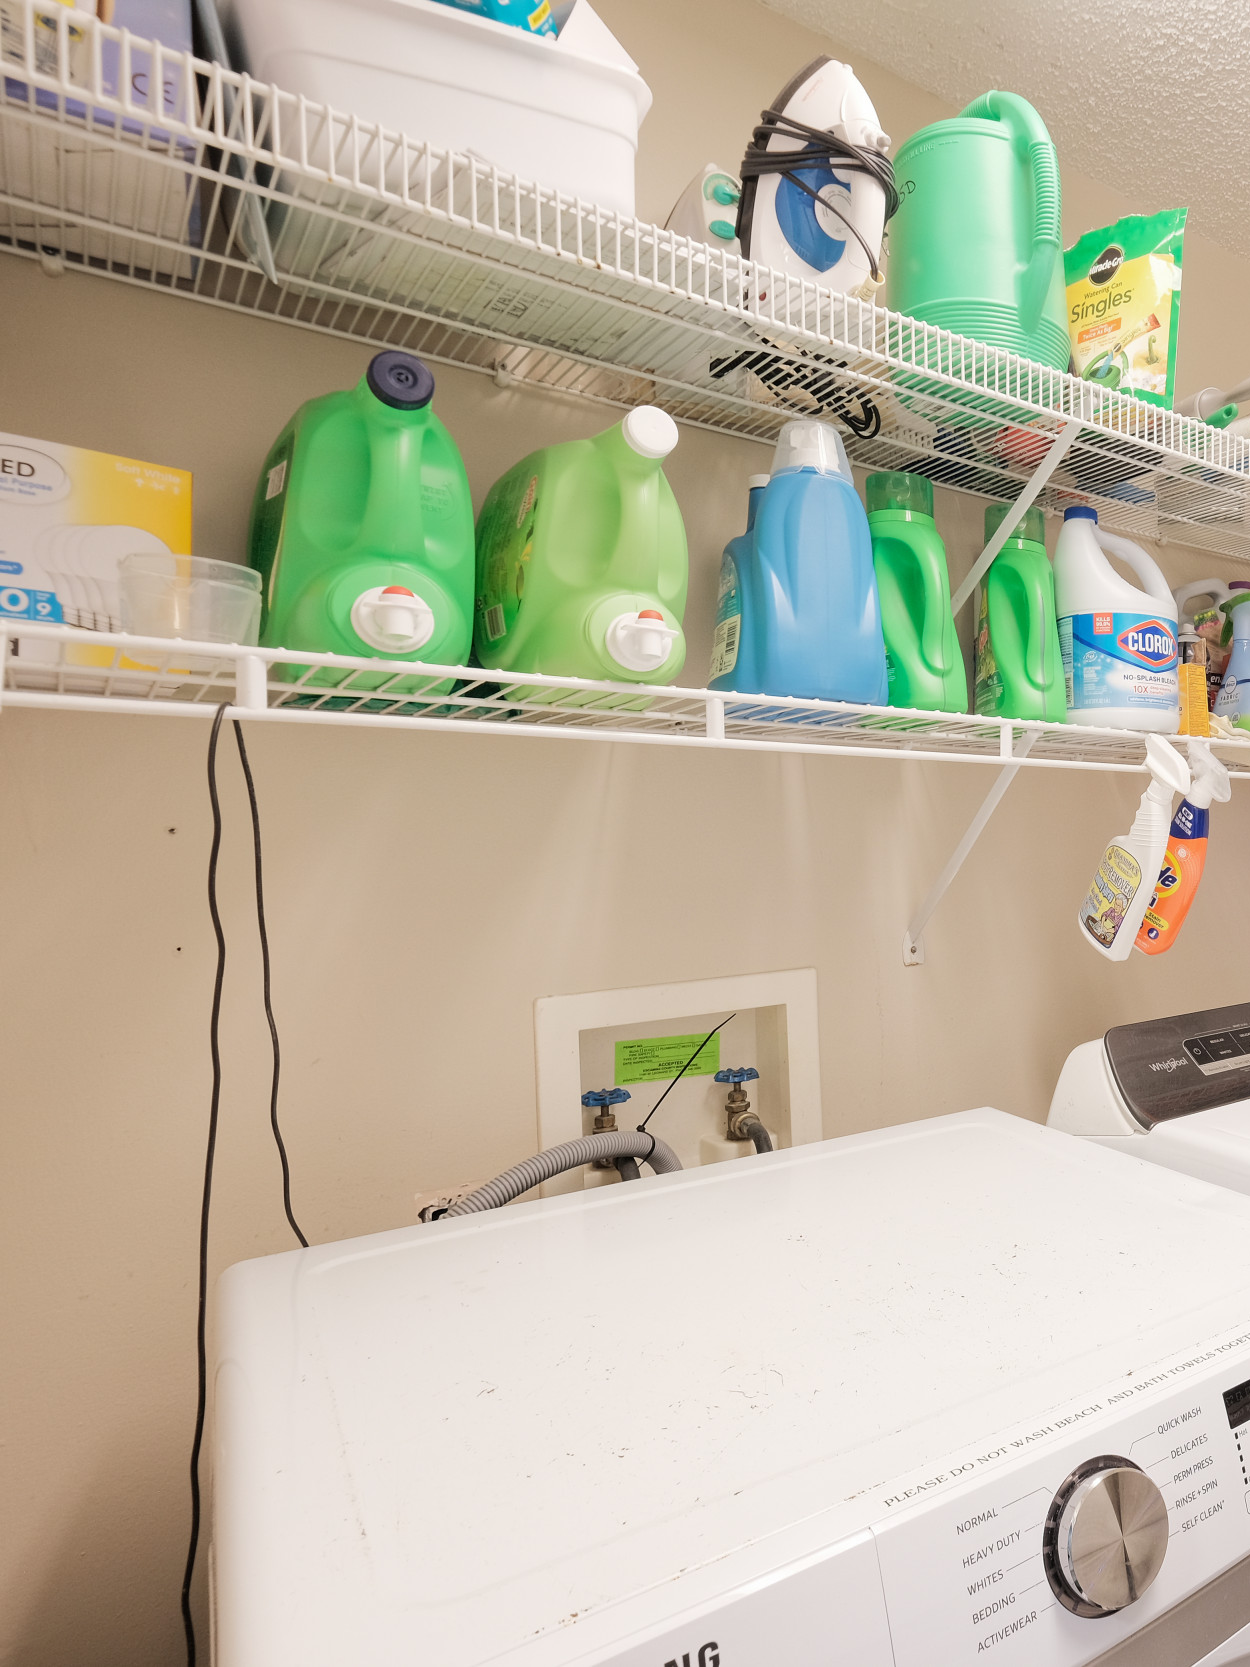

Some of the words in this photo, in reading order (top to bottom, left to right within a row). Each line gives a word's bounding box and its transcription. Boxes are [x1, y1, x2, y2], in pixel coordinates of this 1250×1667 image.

[1089, 255, 1124, 275] Miracle-Gro
[1084, 286, 1110, 299] Watering
[1111, 281, 1123, 289] Can
[1071, 290, 1132, 324] Singles
[115, 462, 140, 475] Soft
[143, 468, 181, 484] White
[1128, 631, 1174, 657] CLOROX
[1123, 674, 1161, 683] NO-SPLASH
[1133, 684, 1149, 694] 10X
[1149, 1056, 1188, 1073] Whirlpool
[884, 1475, 949, 1507] PLEASE
[950, 1462, 975, 1478] DO
[976, 1446, 1010, 1465] NOT
[1010, 1426, 1055, 1448] WASH
[1054, 1404, 1103, 1430] BEACH
[1107, 1389, 1134, 1406] AND
[1134, 1373, 1169, 1392] BATH
[1167, 1351, 1217, 1376] TOWELS
[1157, 1416, 1181, 1435] QUICK
[1181, 1406, 1202, 1423] WASH
[1238, 1428, 1248, 1437] Hot
[1170, 1433, 1209, 1459] DELICATES
[1173, 1467, 1194, 1484] PERM
[1193, 1456, 1214, 1473] PRESS
[1175, 1491, 1197, 1510] RINSE
[1201, 1478, 1218, 1495] SPIN
[956, 1508, 999, 1535] NORMAL
[1182, 1516, 1198, 1533] SELF
[962, 1544, 995, 1568] HEAVY
[997, 1530, 1021, 1551] DUTY
[967, 1569, 1004, 1596] WHITES
[972, 1592, 1016, 1625] BEDDING
[978, 1610, 1038, 1653] ACTIVEWEAR
